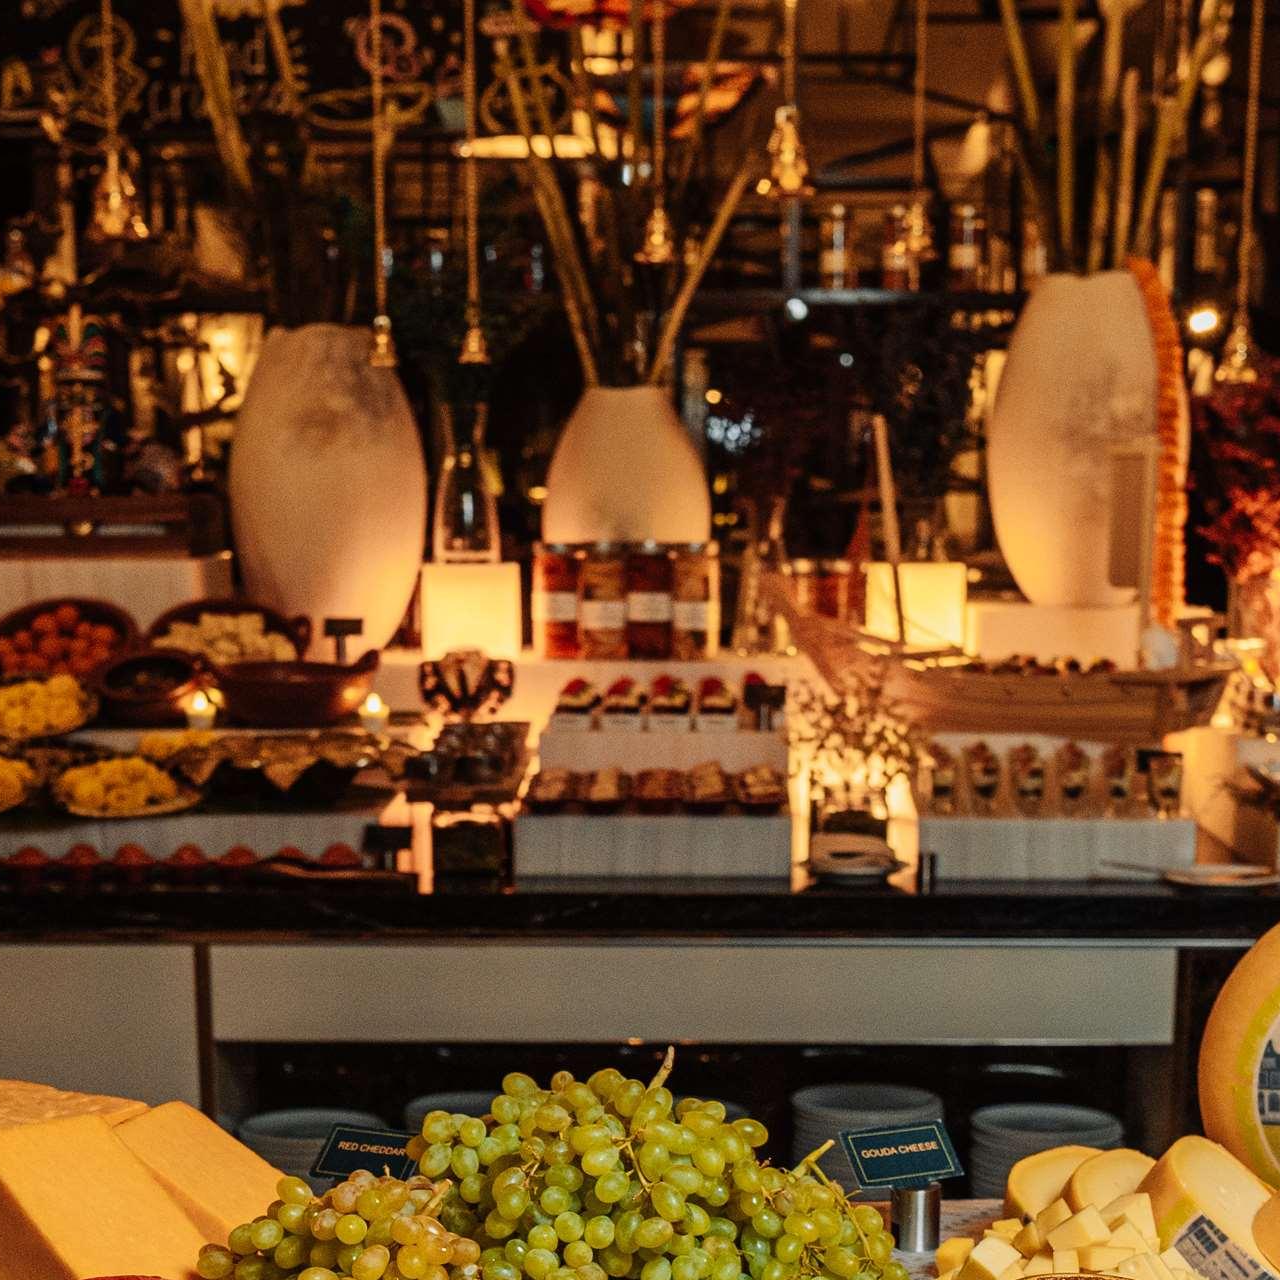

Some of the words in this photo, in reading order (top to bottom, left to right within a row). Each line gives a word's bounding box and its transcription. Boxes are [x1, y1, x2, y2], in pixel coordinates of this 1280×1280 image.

[337, 1141, 359, 1152] RED
[360, 1144, 407, 1156] CHEDDAR
[861, 1148, 897, 1159] GOUDA
[898, 1141, 939, 1154] CHEESE
